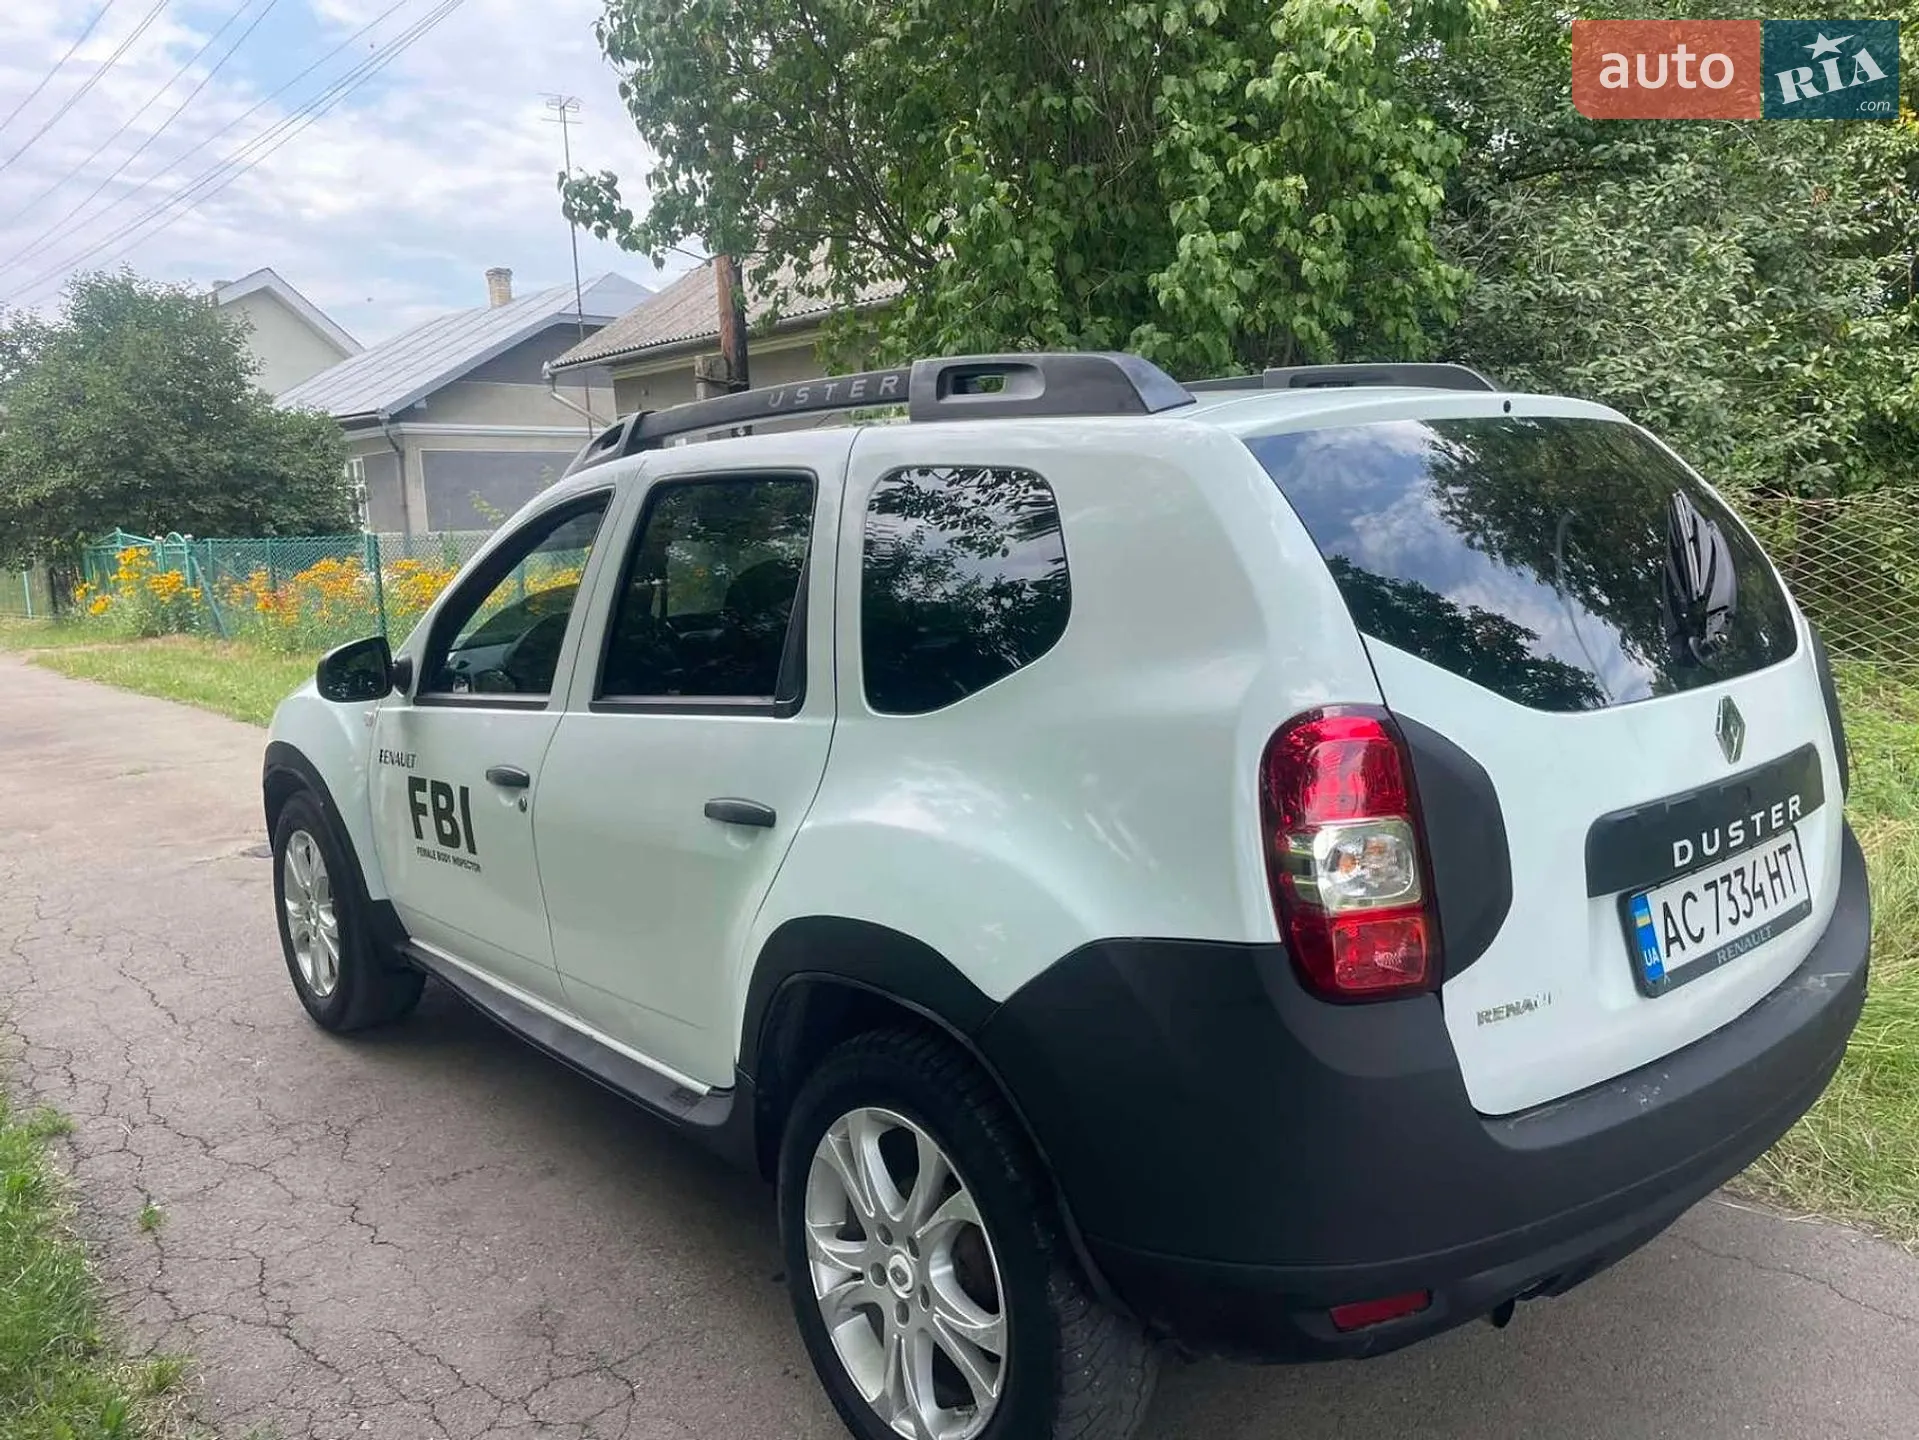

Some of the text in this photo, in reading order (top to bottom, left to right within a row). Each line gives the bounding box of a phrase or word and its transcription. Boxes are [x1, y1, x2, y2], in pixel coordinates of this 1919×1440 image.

[408, 775, 477, 855] FBI
[1673, 794, 1801, 868] DUSTER
[1662, 843, 1797, 957] AC 7334 HT
[1644, 951, 1660, 966] UA
[1717, 924, 1773, 964] RENAULT
